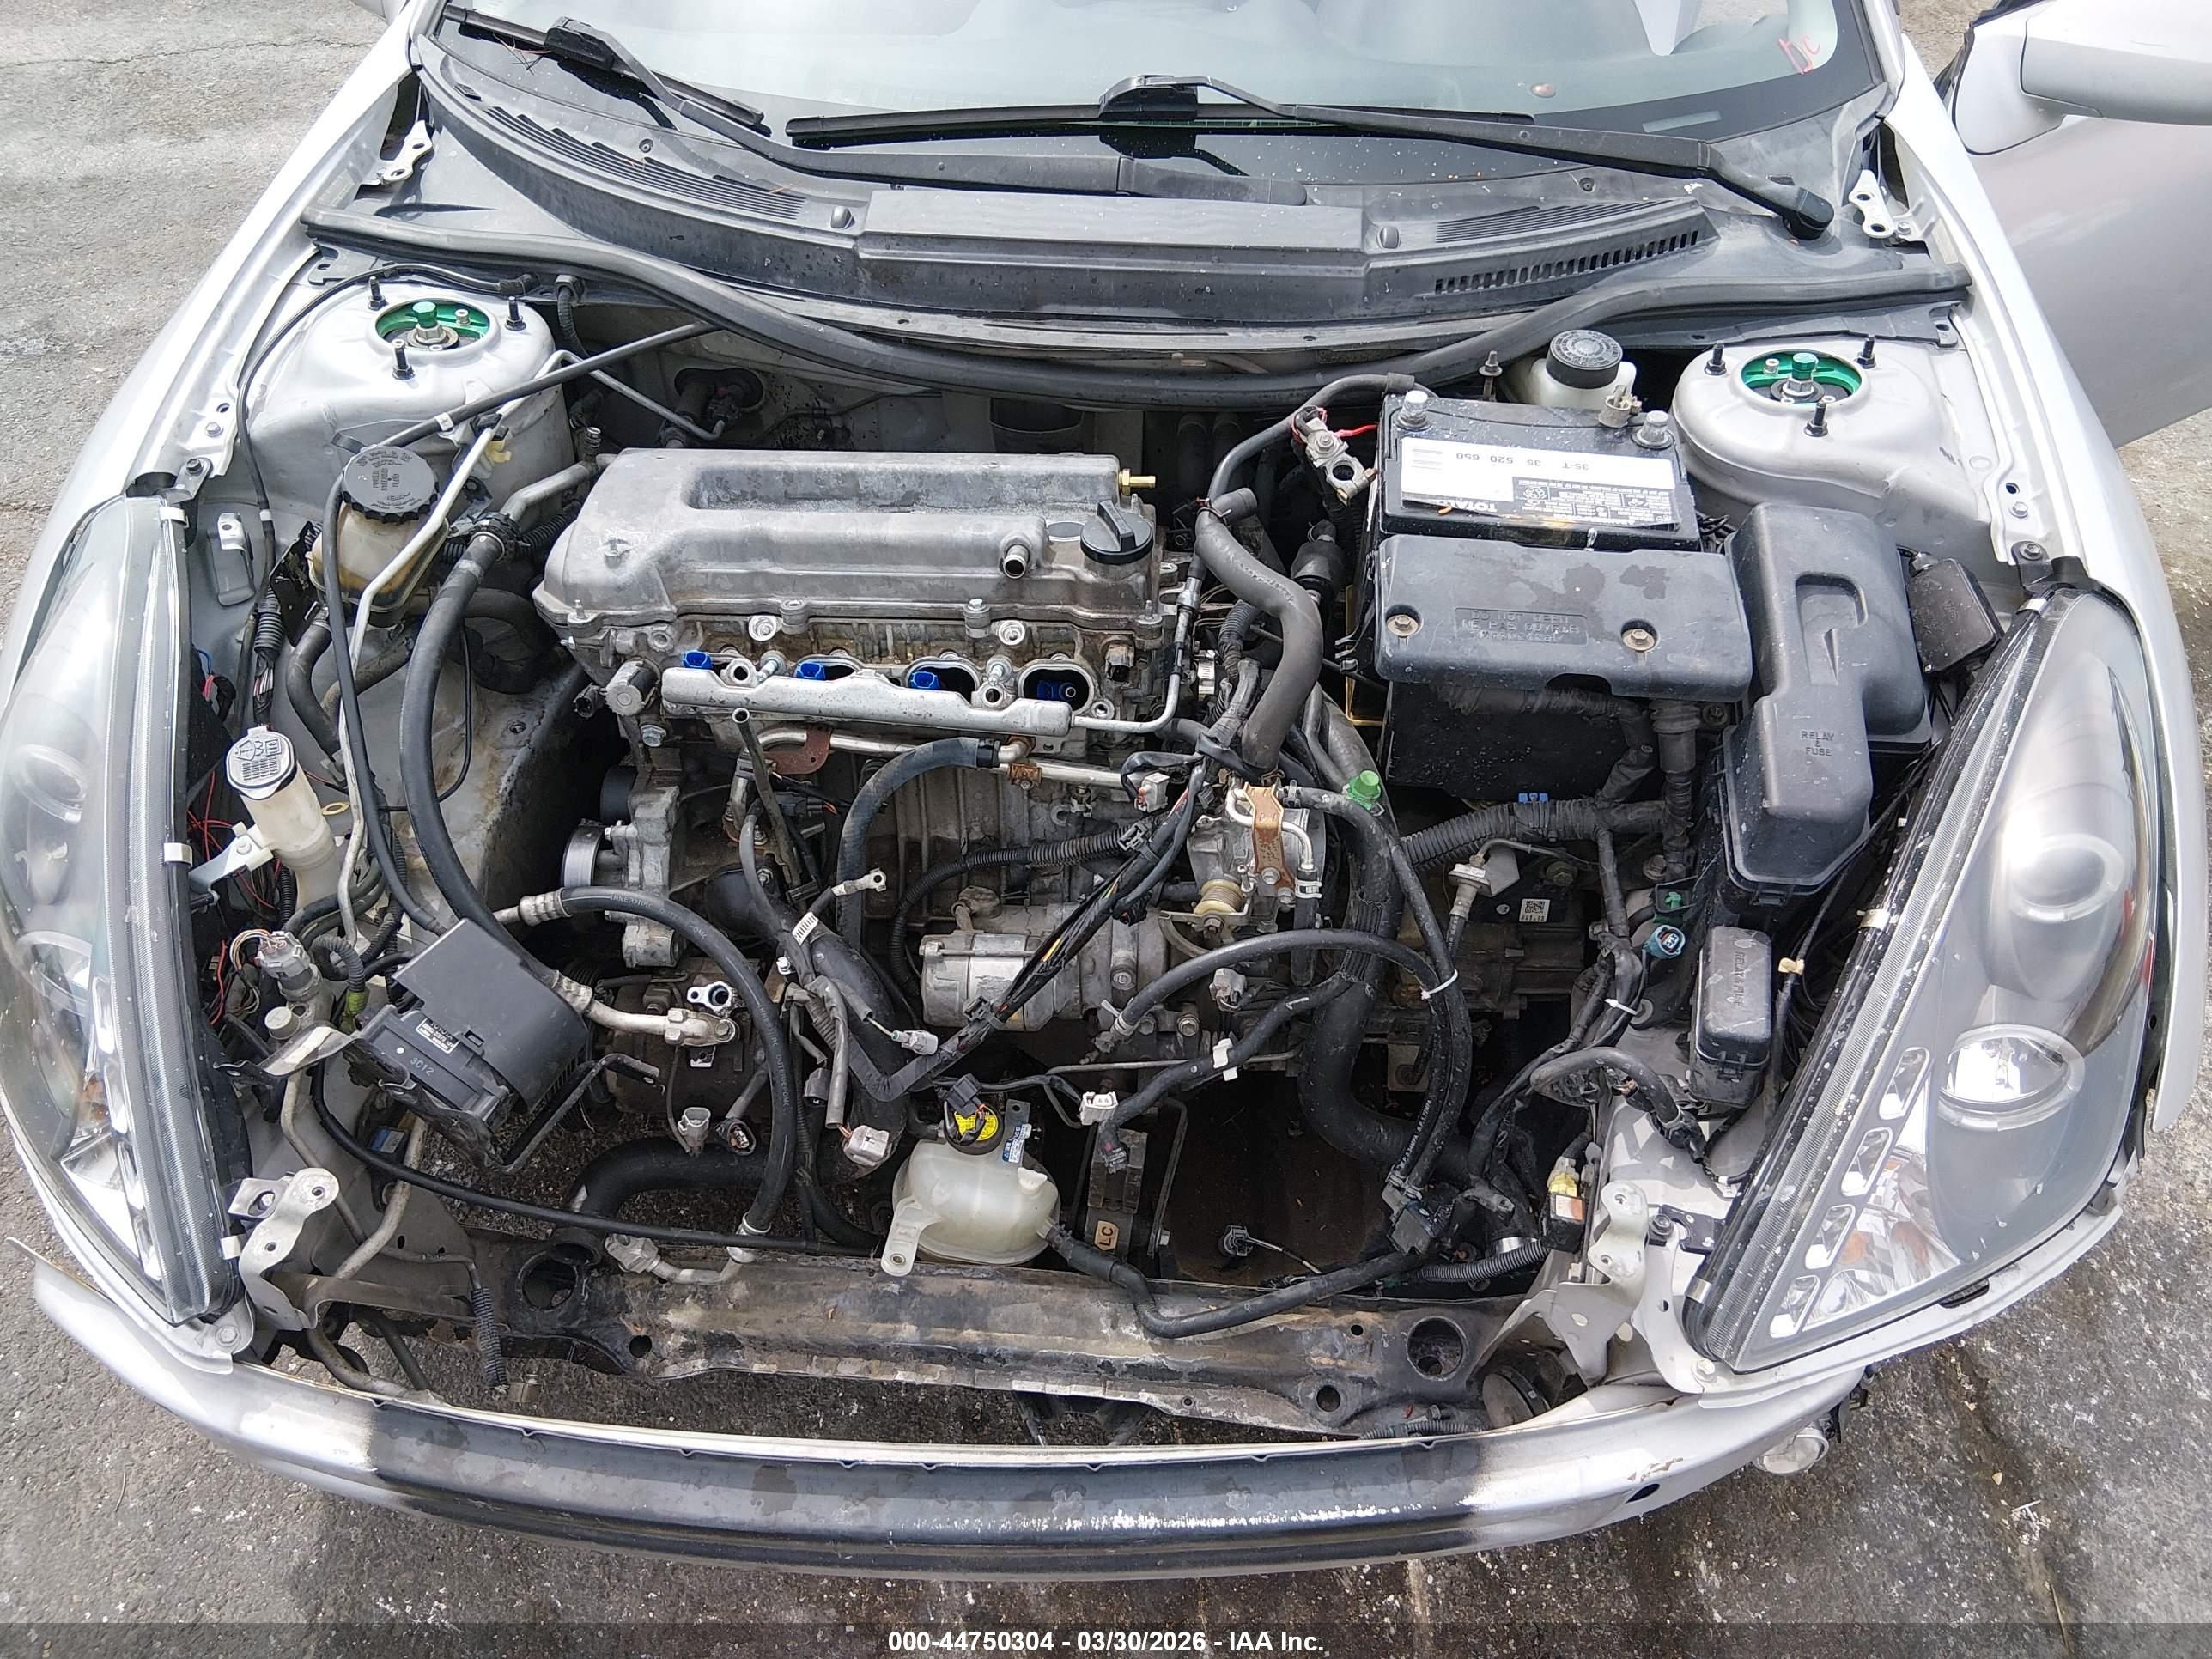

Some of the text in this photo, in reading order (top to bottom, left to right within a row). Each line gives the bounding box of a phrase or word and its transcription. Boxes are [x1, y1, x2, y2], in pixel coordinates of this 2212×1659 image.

[1455, 453, 1589, 471] 35-T 35 520 650
[1469, 610, 1491, 620] DO
[1497, 611, 1523, 622] NOT
[1462, 619, 1480, 630] NE
[1489, 621, 1516, 631] PAS
[1801, 730, 1835, 742] RELAY
[1805, 746, 1833, 757] FUSE
[1733, 951, 1746, 977] RELAY
[410, 1056, 435, 1076] 3C12
[1099, 1225, 1115, 1247] LC
